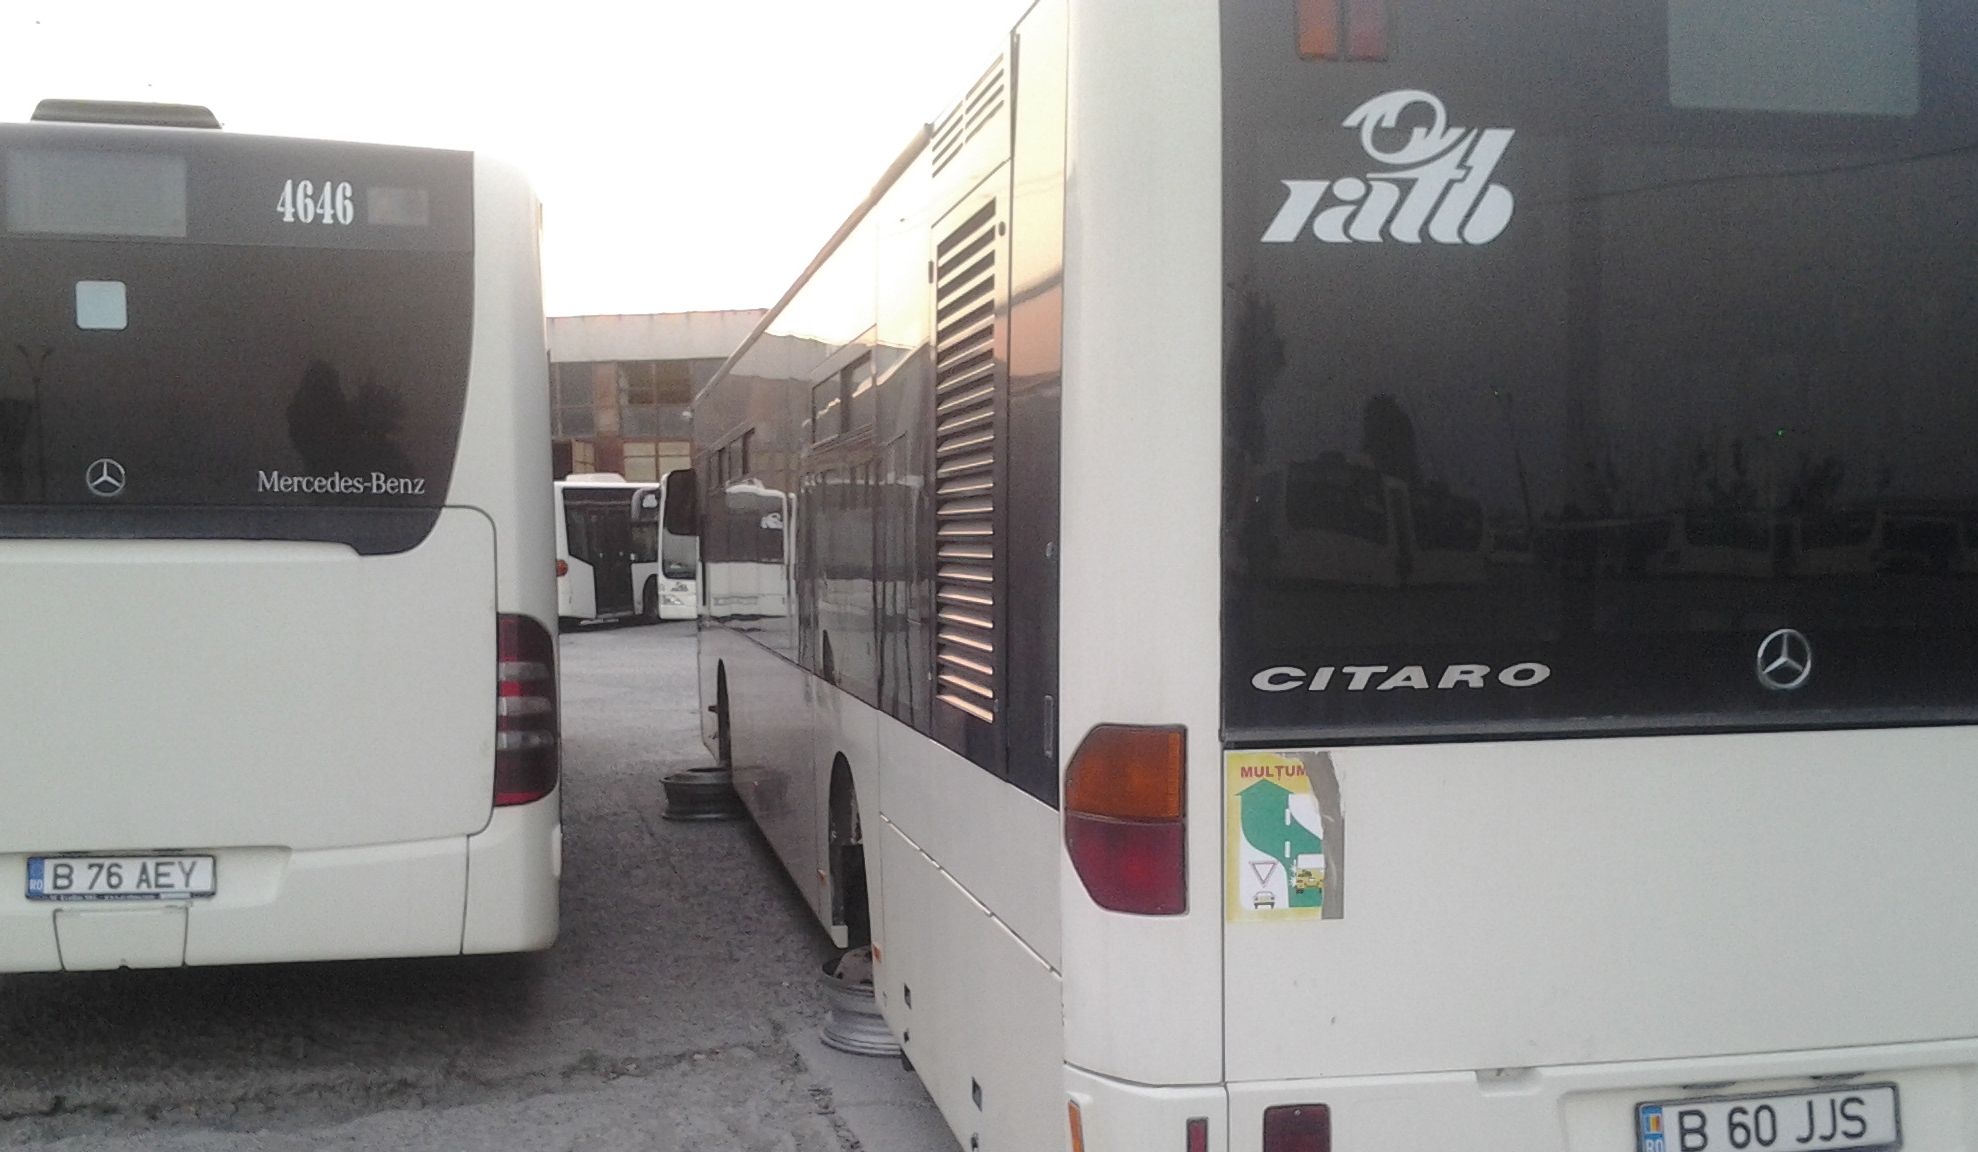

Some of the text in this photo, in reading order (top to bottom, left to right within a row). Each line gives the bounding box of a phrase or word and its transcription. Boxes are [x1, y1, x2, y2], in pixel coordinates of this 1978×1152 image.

[276, 179, 354, 225] 4646
[257, 470, 425, 495] Mercedes-Benz
[1251, 662, 1551, 692] CITARO
[53, 860, 197, 891] B 76 AEY
[1678, 1097, 1867, 1152] B 60 JJS
